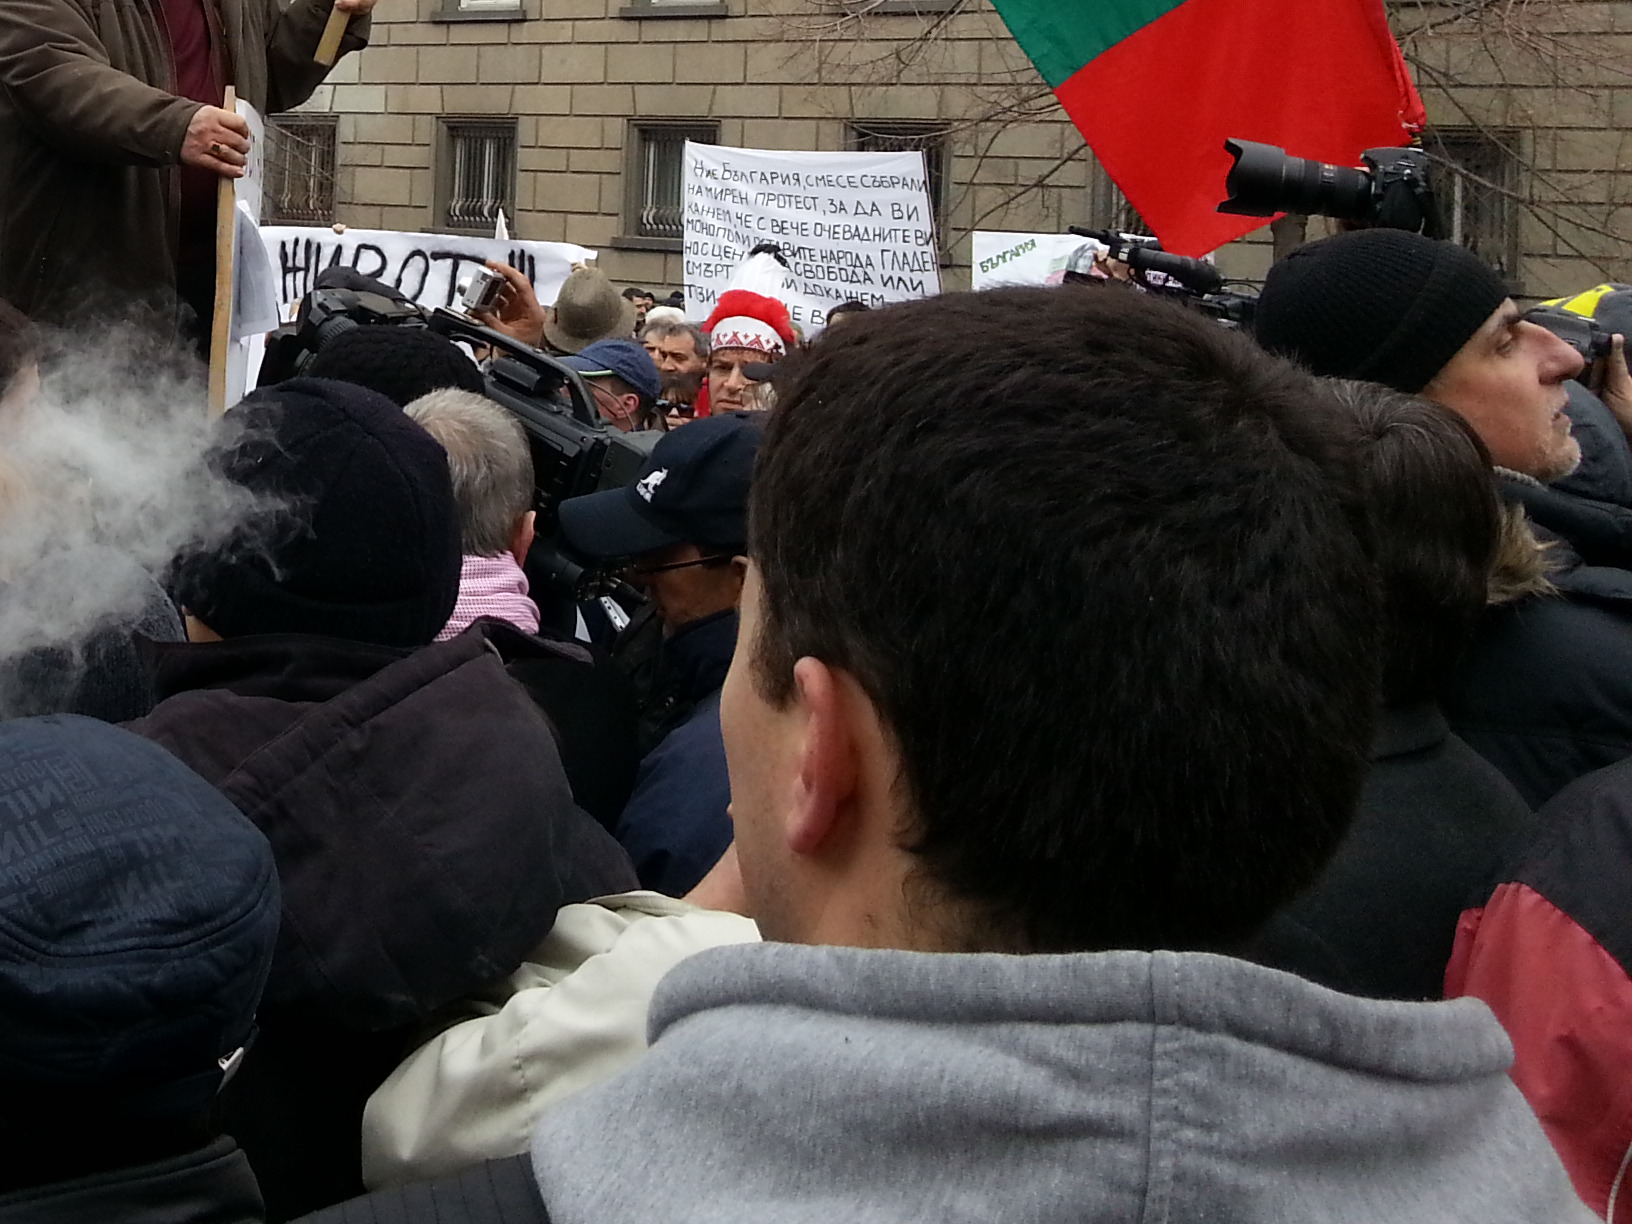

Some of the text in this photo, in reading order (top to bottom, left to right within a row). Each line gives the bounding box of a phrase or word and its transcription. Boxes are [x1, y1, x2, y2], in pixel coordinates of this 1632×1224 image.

[860, 174, 928, 193] СЪБРАЛИ
[705, 186, 749, 206] МИРЕН
[853, 199, 882, 217] ДА
[891, 202, 920, 222] ВИ
[735, 211, 753, 230] ЧЕ
[756, 216, 767, 231] С
[770, 218, 808, 237] ВЕЧЕ
[686, 217, 751, 248] МОНОПОЛИ
[819, 249, 875, 272] НАРОДА
[794, 261, 875, 285] СВОБОДА
[880, 273, 926, 296] ИЛИ
